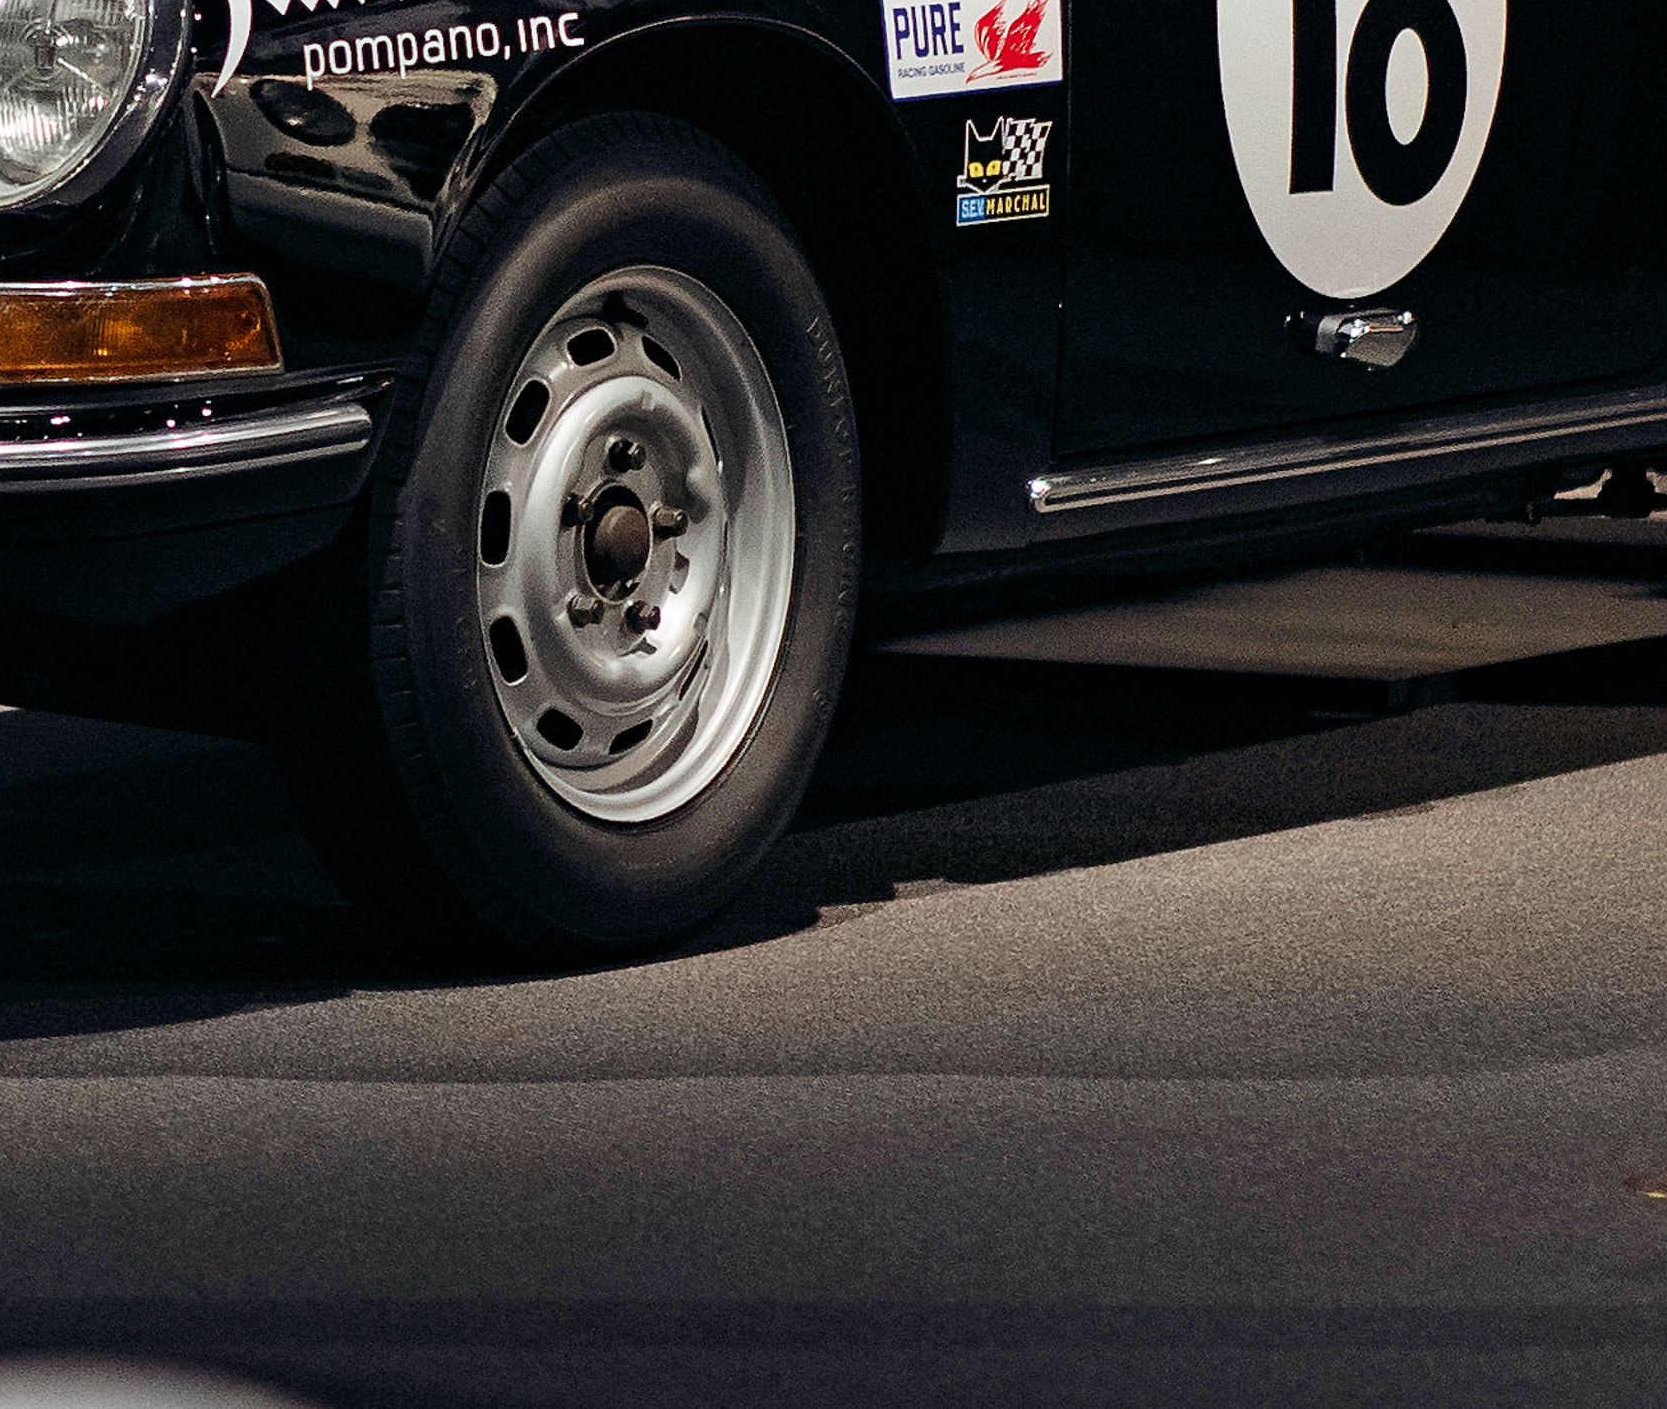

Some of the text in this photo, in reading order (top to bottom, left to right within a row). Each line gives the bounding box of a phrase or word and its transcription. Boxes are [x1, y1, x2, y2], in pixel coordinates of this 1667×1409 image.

[893, 1, 964, 60] PURE
[897, 61, 966, 79] RACING GASOLINE
